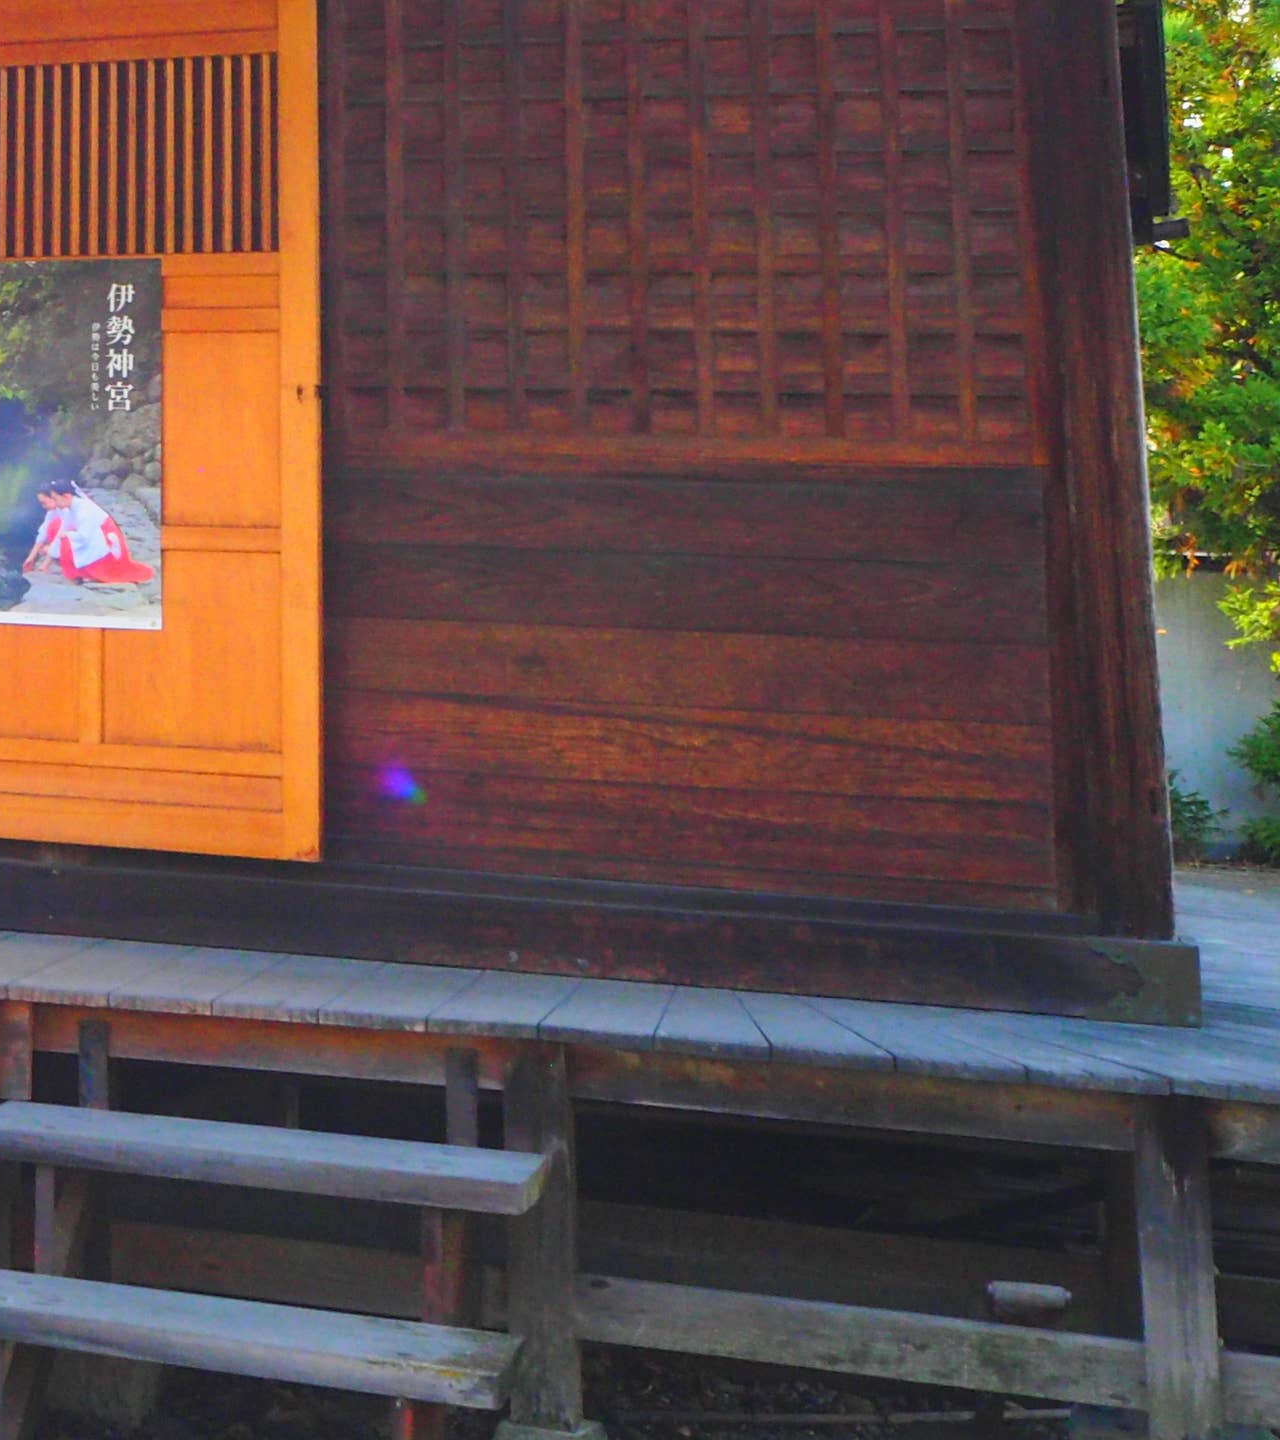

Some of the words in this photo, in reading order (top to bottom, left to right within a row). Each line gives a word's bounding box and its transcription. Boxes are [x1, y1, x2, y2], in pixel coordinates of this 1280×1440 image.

[91, 322, 100, 411] 伊勢は今日も美しい
[105, 284, 135, 412] 伊勢神宮
